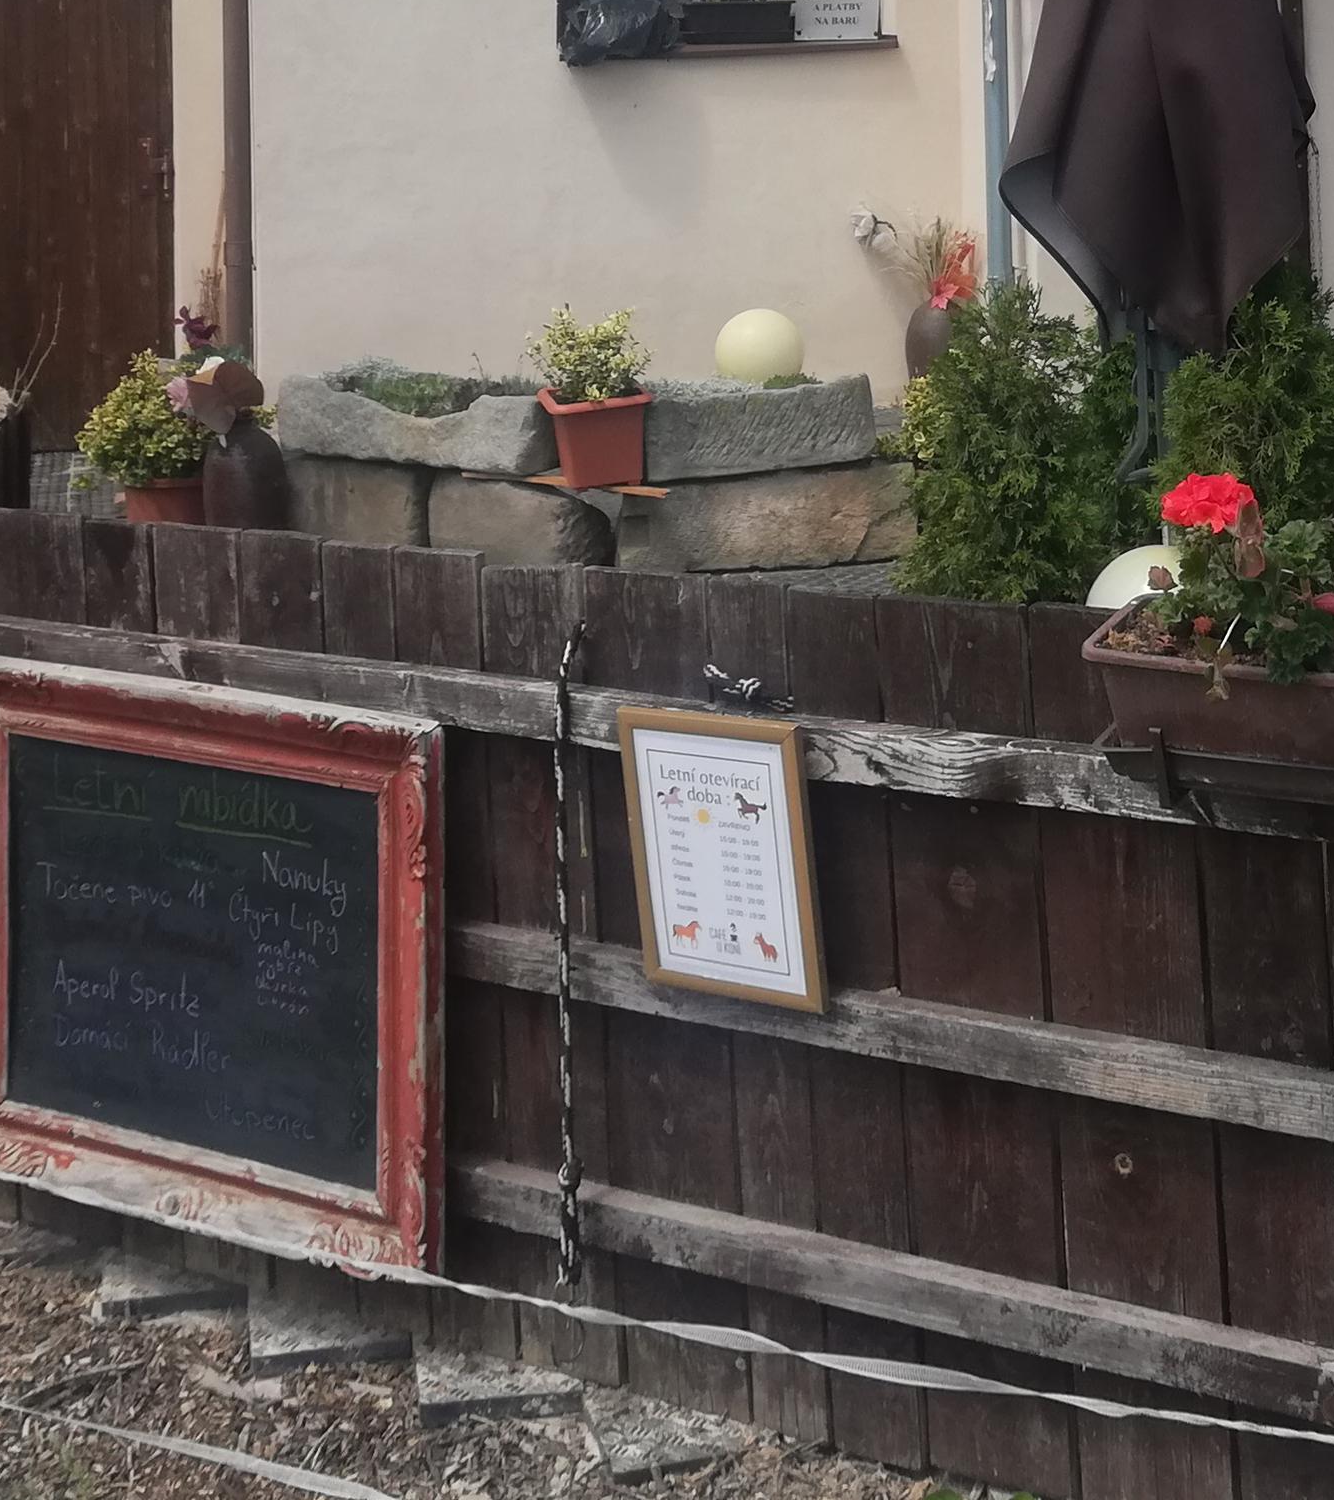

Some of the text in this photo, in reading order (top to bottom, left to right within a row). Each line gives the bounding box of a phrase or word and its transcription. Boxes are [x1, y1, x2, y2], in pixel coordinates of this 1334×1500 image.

[822, 2, 862, 12] PLATBY
[814, 16, 829, 26] NA
[659, 763, 760, 791] Letní otevírací
[686, 786, 722, 805] doba
[262, 850, 347, 918] Nanuky
[127, 885, 172, 910] pivo
[258, 940, 319, 969] malina
[52, 958, 202, 1019] Aperol Spritz
